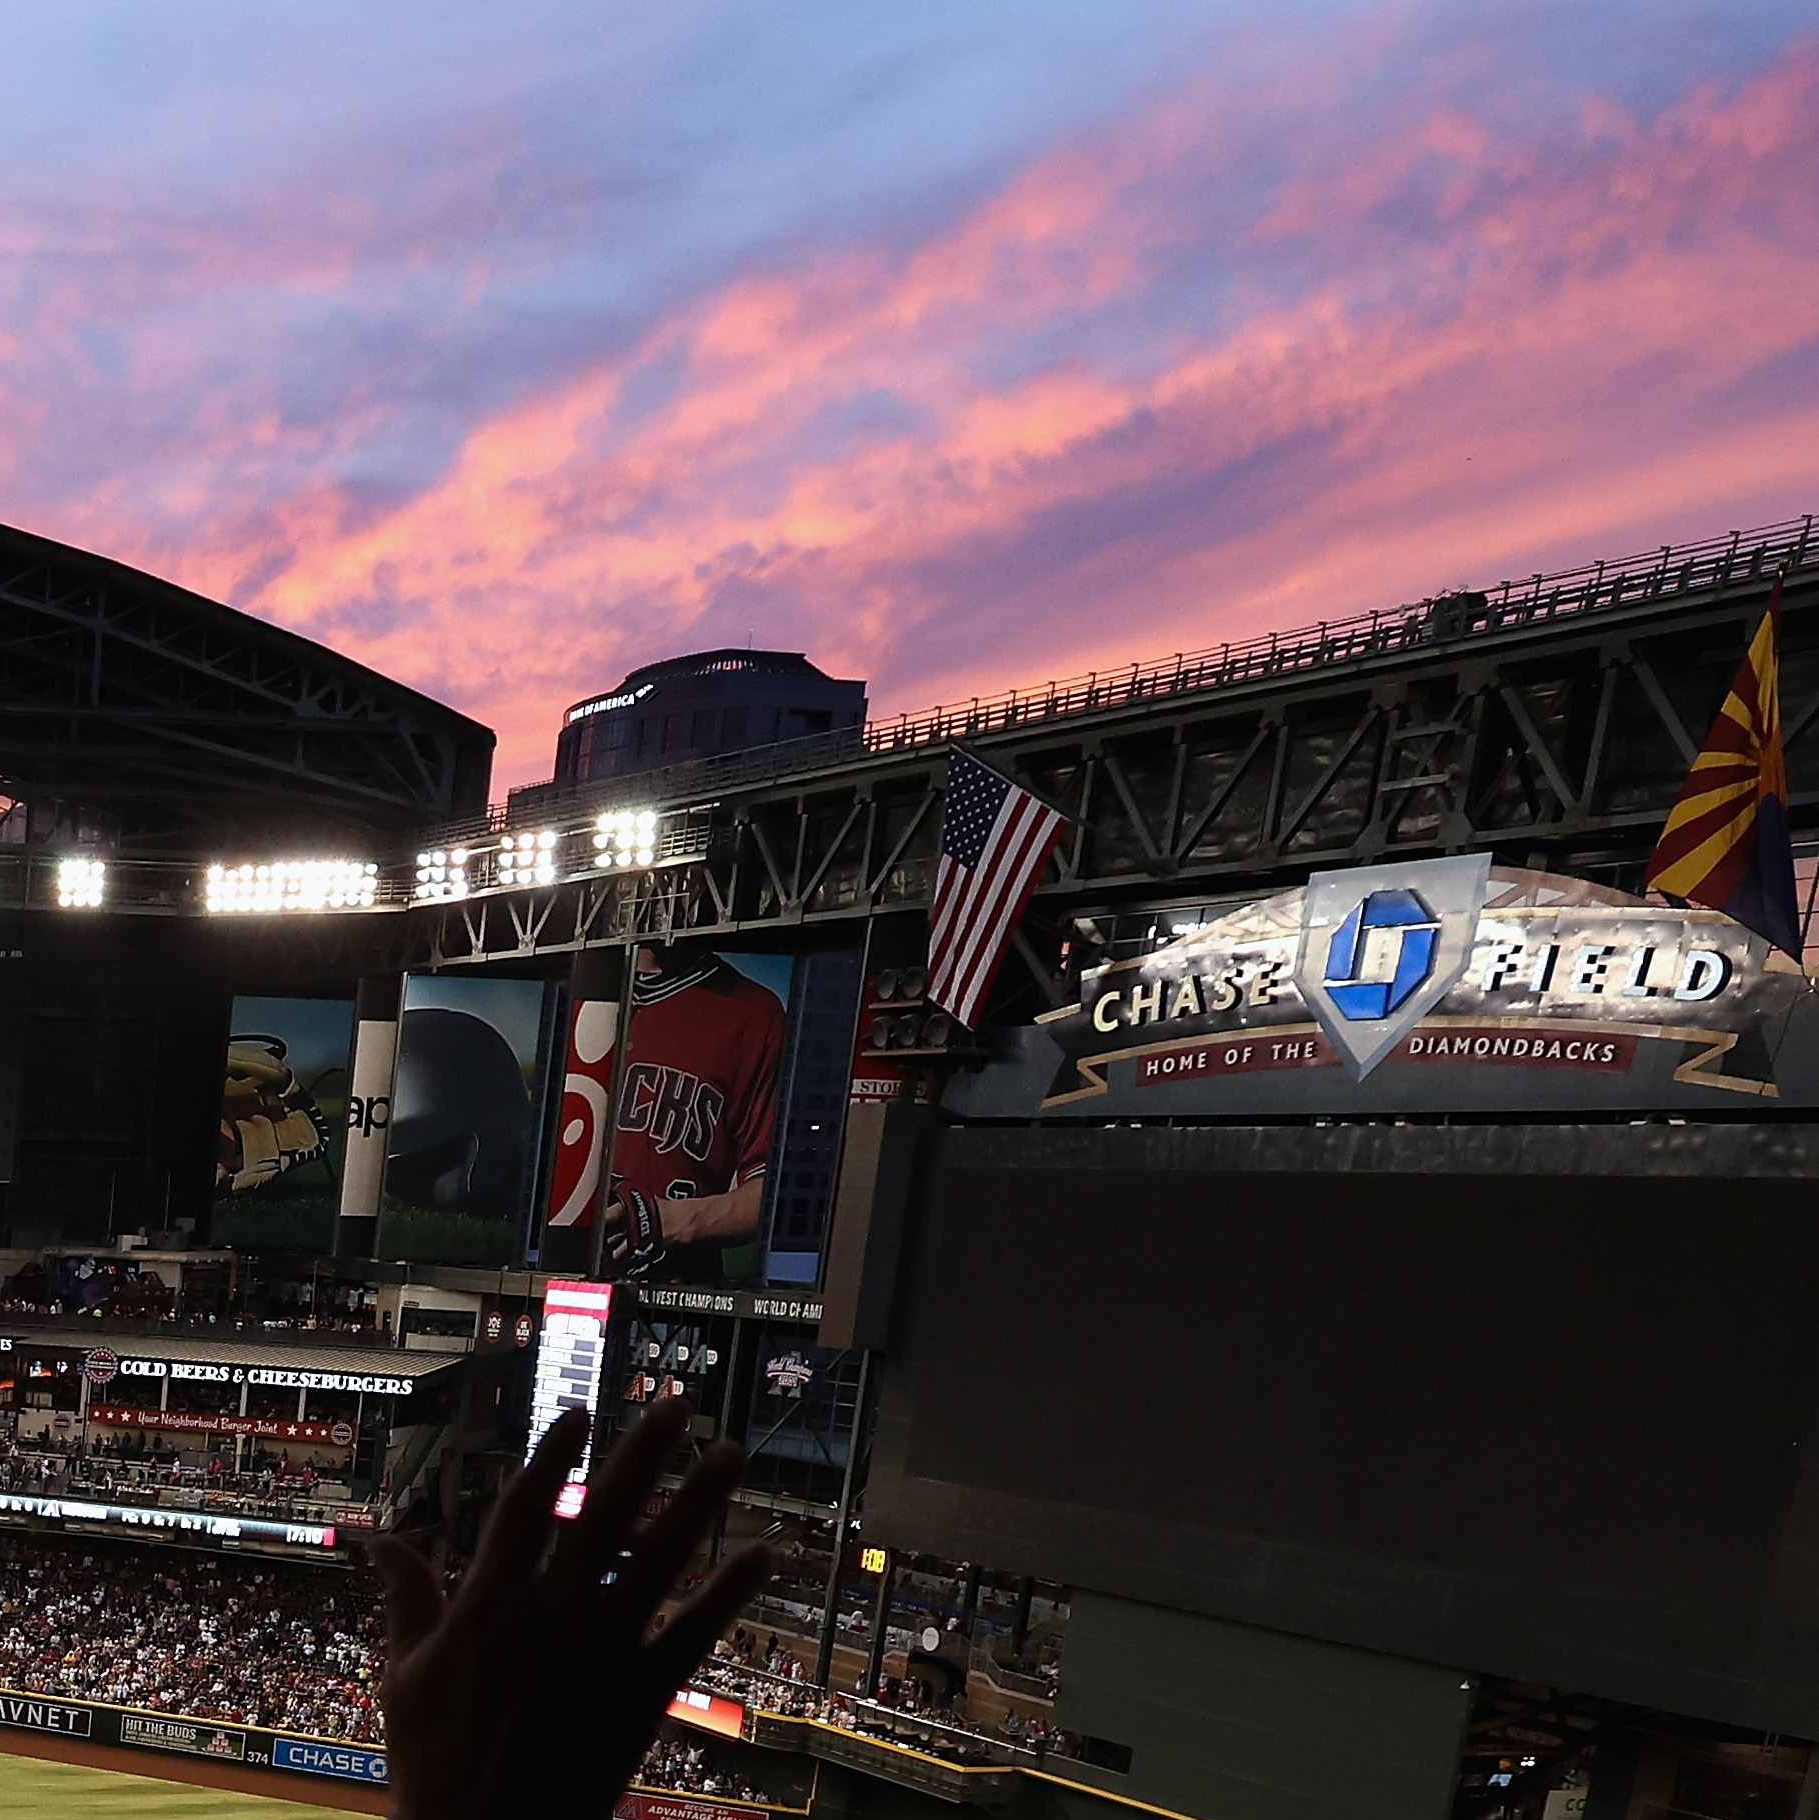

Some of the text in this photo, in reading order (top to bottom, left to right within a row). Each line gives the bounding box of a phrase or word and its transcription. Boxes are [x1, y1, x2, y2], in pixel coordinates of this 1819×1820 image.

[569, 706, 584, 722] BANK
[593, 694, 635, 712] AMERICA
[1093, 942, 1734, 1033] CHASE FIELD
[1146, 1035, 1617, 1077] HOME OF THE DIAMONDBACKS
[631, 1190, 650, 1237] Wilson
[639, 1289, 649, 1303] NL
[753, 1298, 787, 1316] WORLD
[121, 1360, 167, 1377] COLD
[170, 1363, 229, 1383] BEERS
[233, 1368, 244, 1384] &
[248, 1369, 413, 1395] CHEESEBURGERS
[138, 1411, 278, 1435] Your Neighborhood Burger Joint
[126, 1717, 198, 1742] HIT THE BUDS
[247, 1750, 269, 1765] 374
[289, 1747, 366, 1774] CHASE
[683, 1803, 731, 1818] BECOME AN
